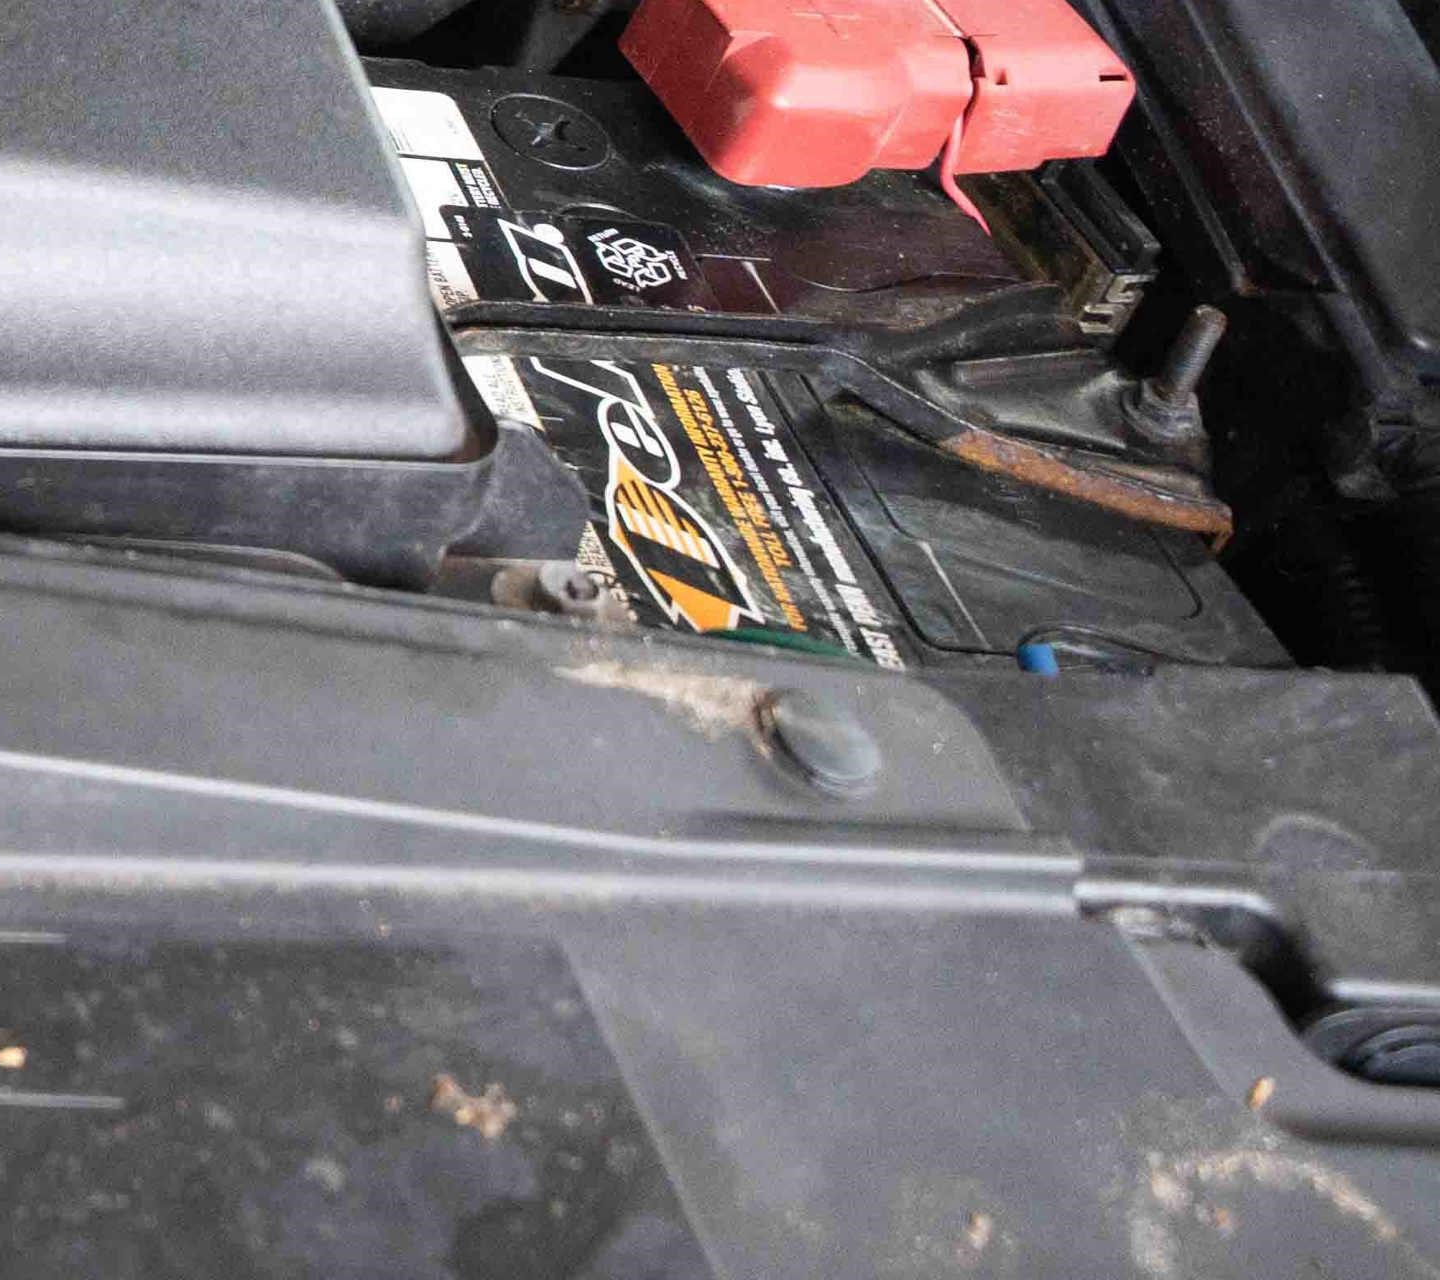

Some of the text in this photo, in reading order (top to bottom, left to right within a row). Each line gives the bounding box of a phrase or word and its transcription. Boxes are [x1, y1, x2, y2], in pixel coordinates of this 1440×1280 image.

[649, 362, 709, 446] INFORMATION
[740, 403, 779, 435] Lyon
[693, 445, 749, 519] WARRANTY
[736, 490, 773, 529] FREE
[732, 518, 794, 603] NATIONWIDE
[757, 529, 795, 568] TOLL
[780, 485, 863, 585] manufacturing
[858, 626, 907, 671] EAST
